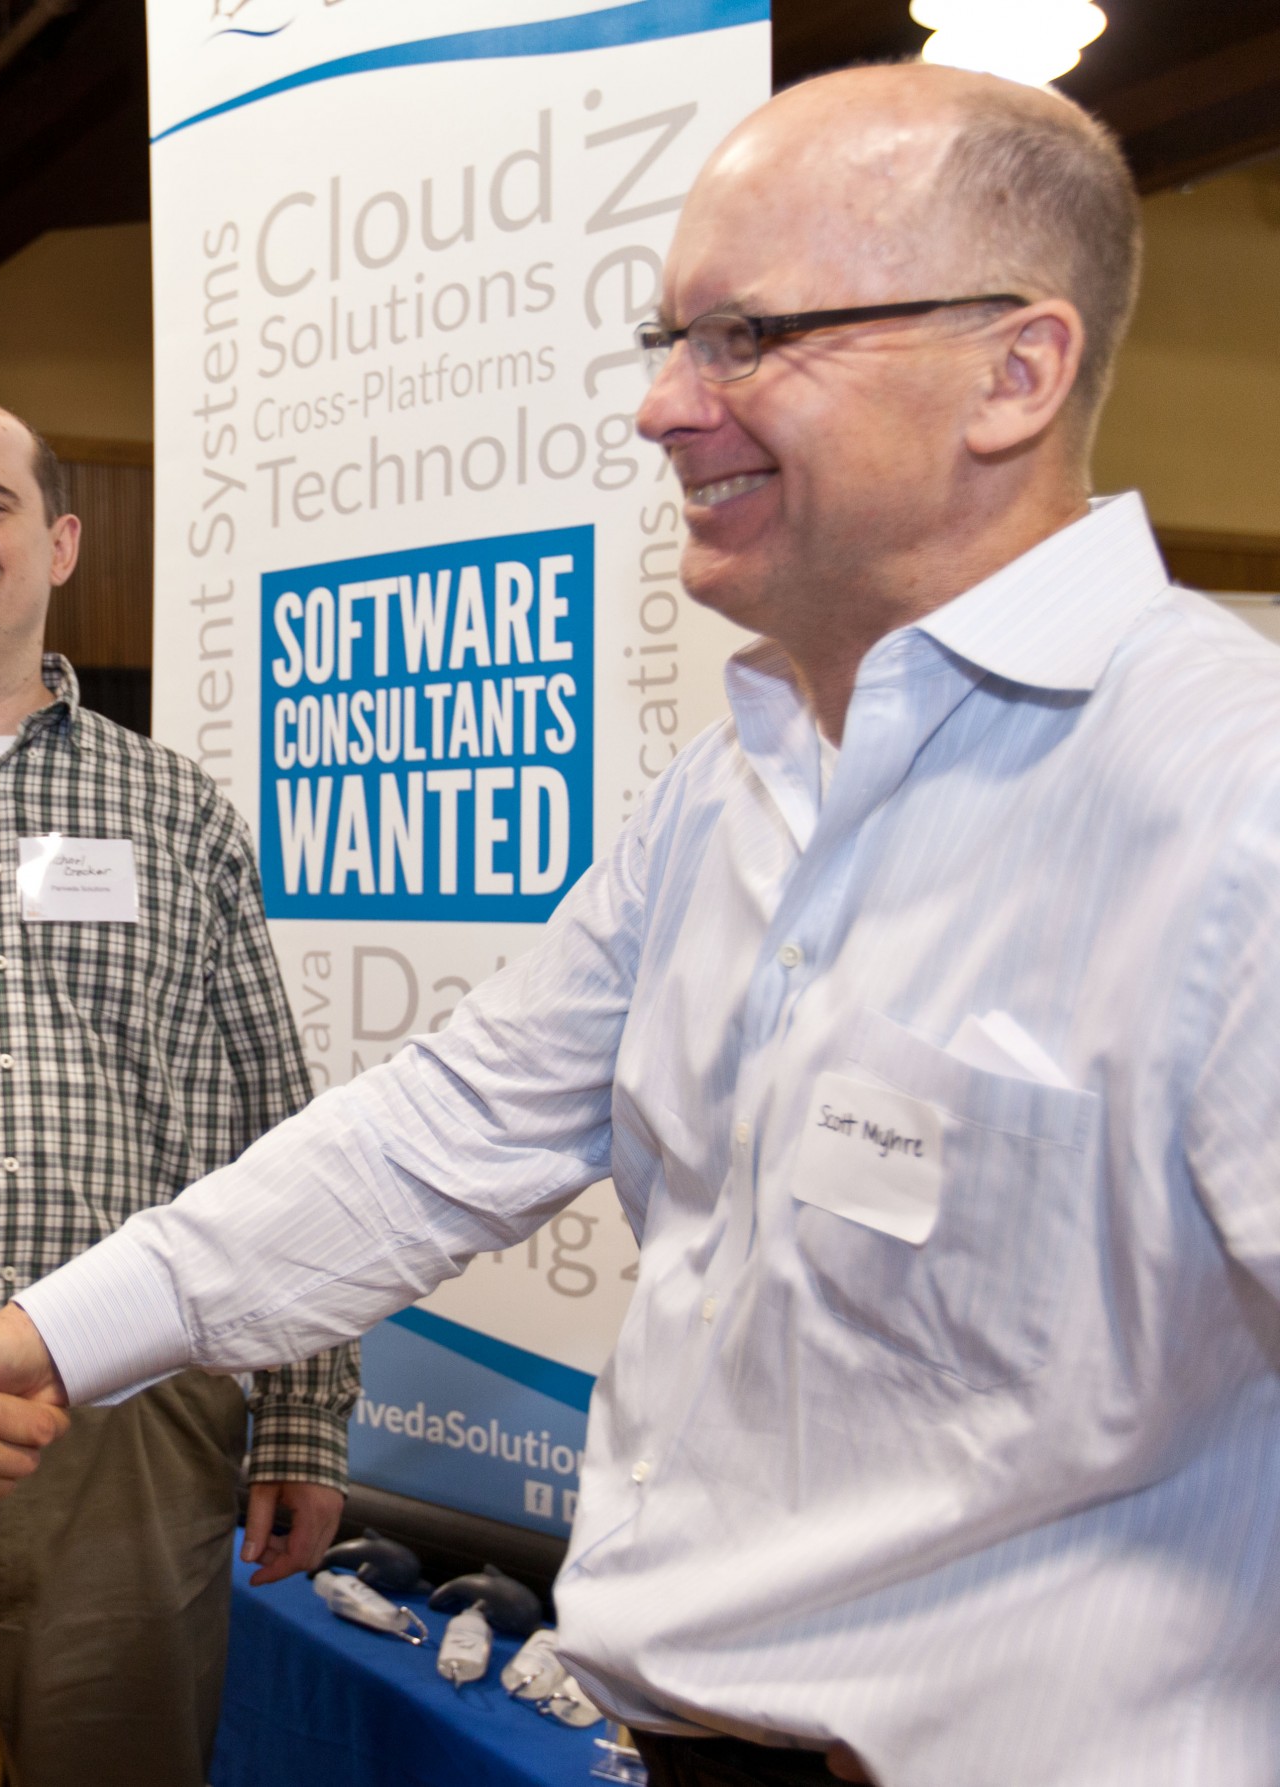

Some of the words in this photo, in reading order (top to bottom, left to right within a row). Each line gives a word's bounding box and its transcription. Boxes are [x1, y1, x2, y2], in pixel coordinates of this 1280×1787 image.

[254, 107, 553, 298] Cloud
[258, 259, 556, 379] Solutions
[189, 220, 248, 559] Systems
[253, 345, 556, 443] Cross-Platforms
[257, 405, 670, 528] Technolog
[272, 553, 575, 688] SOFTWARE
[273, 673, 578, 771] CONSULTANTS
[275, 765, 571, 896] WANTED
[817, 1104, 859, 1137] Scott
